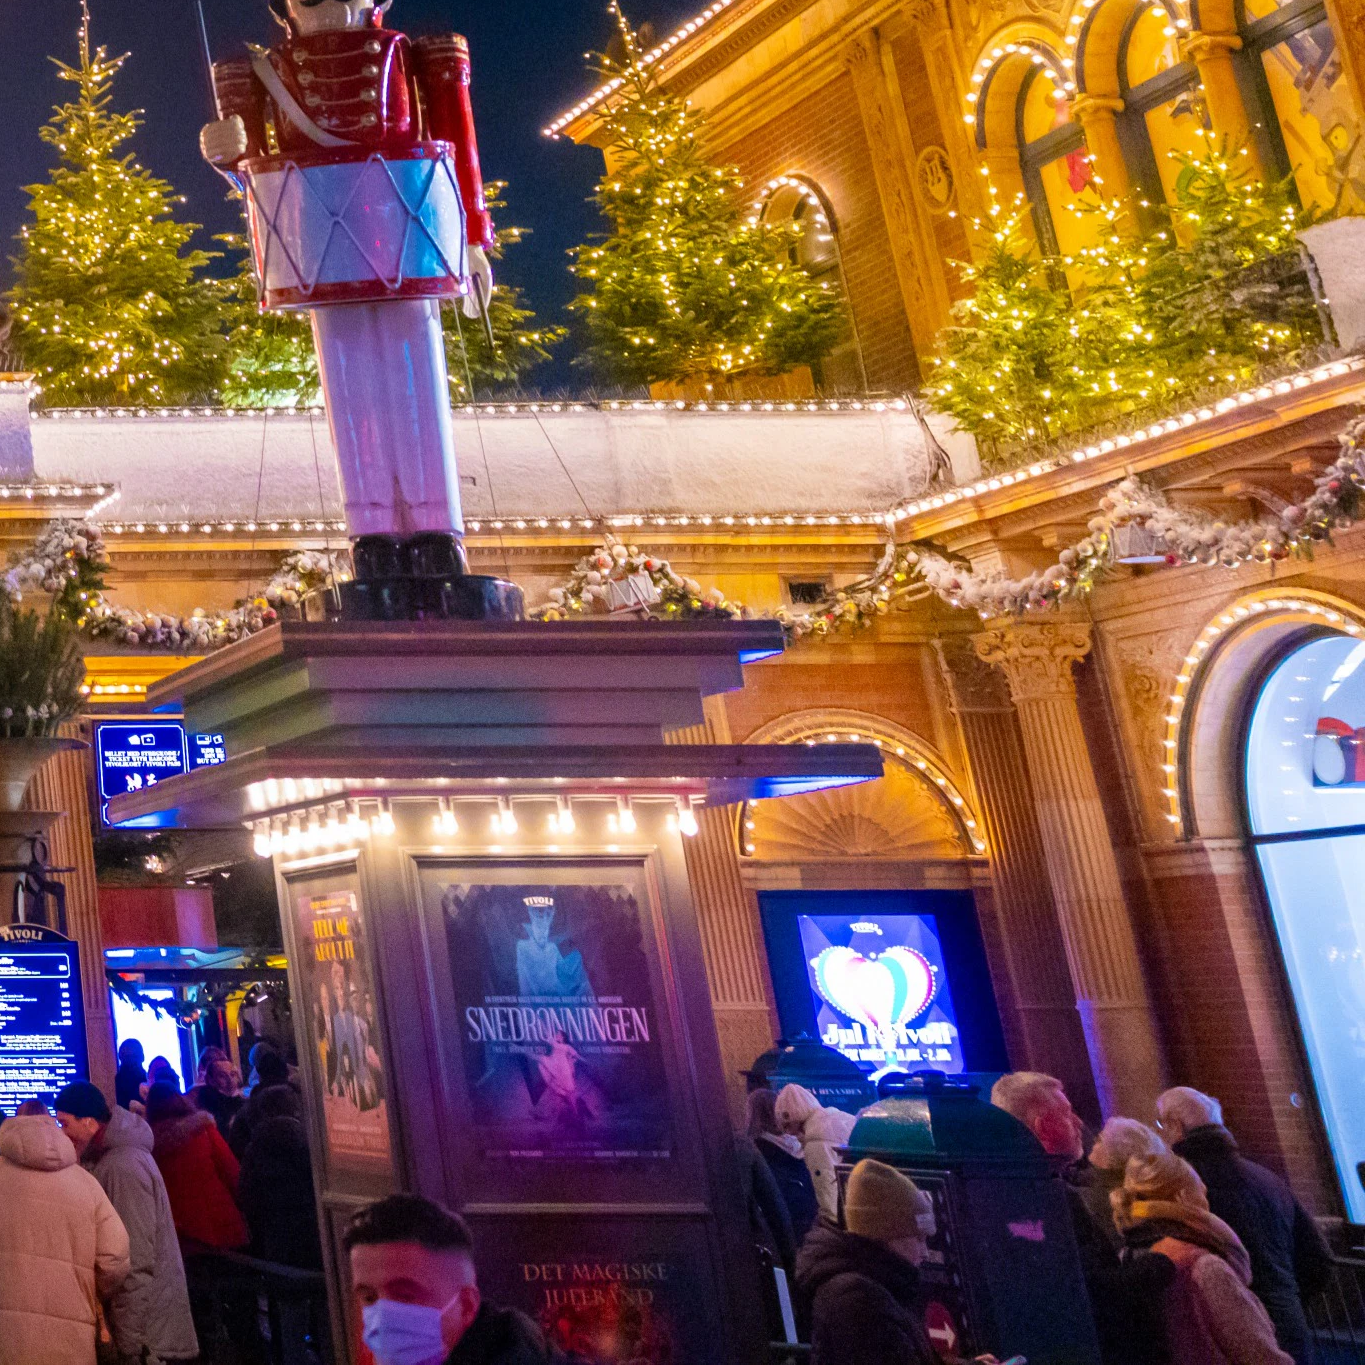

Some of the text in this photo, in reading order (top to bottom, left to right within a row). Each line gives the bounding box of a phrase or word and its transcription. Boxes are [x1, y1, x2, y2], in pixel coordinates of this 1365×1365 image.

[523, 896, 555, 907] TIVOLI
[466, 1006, 650, 1042] SNEDRONNINGEN
[822, 1023, 864, 1045] Jul
